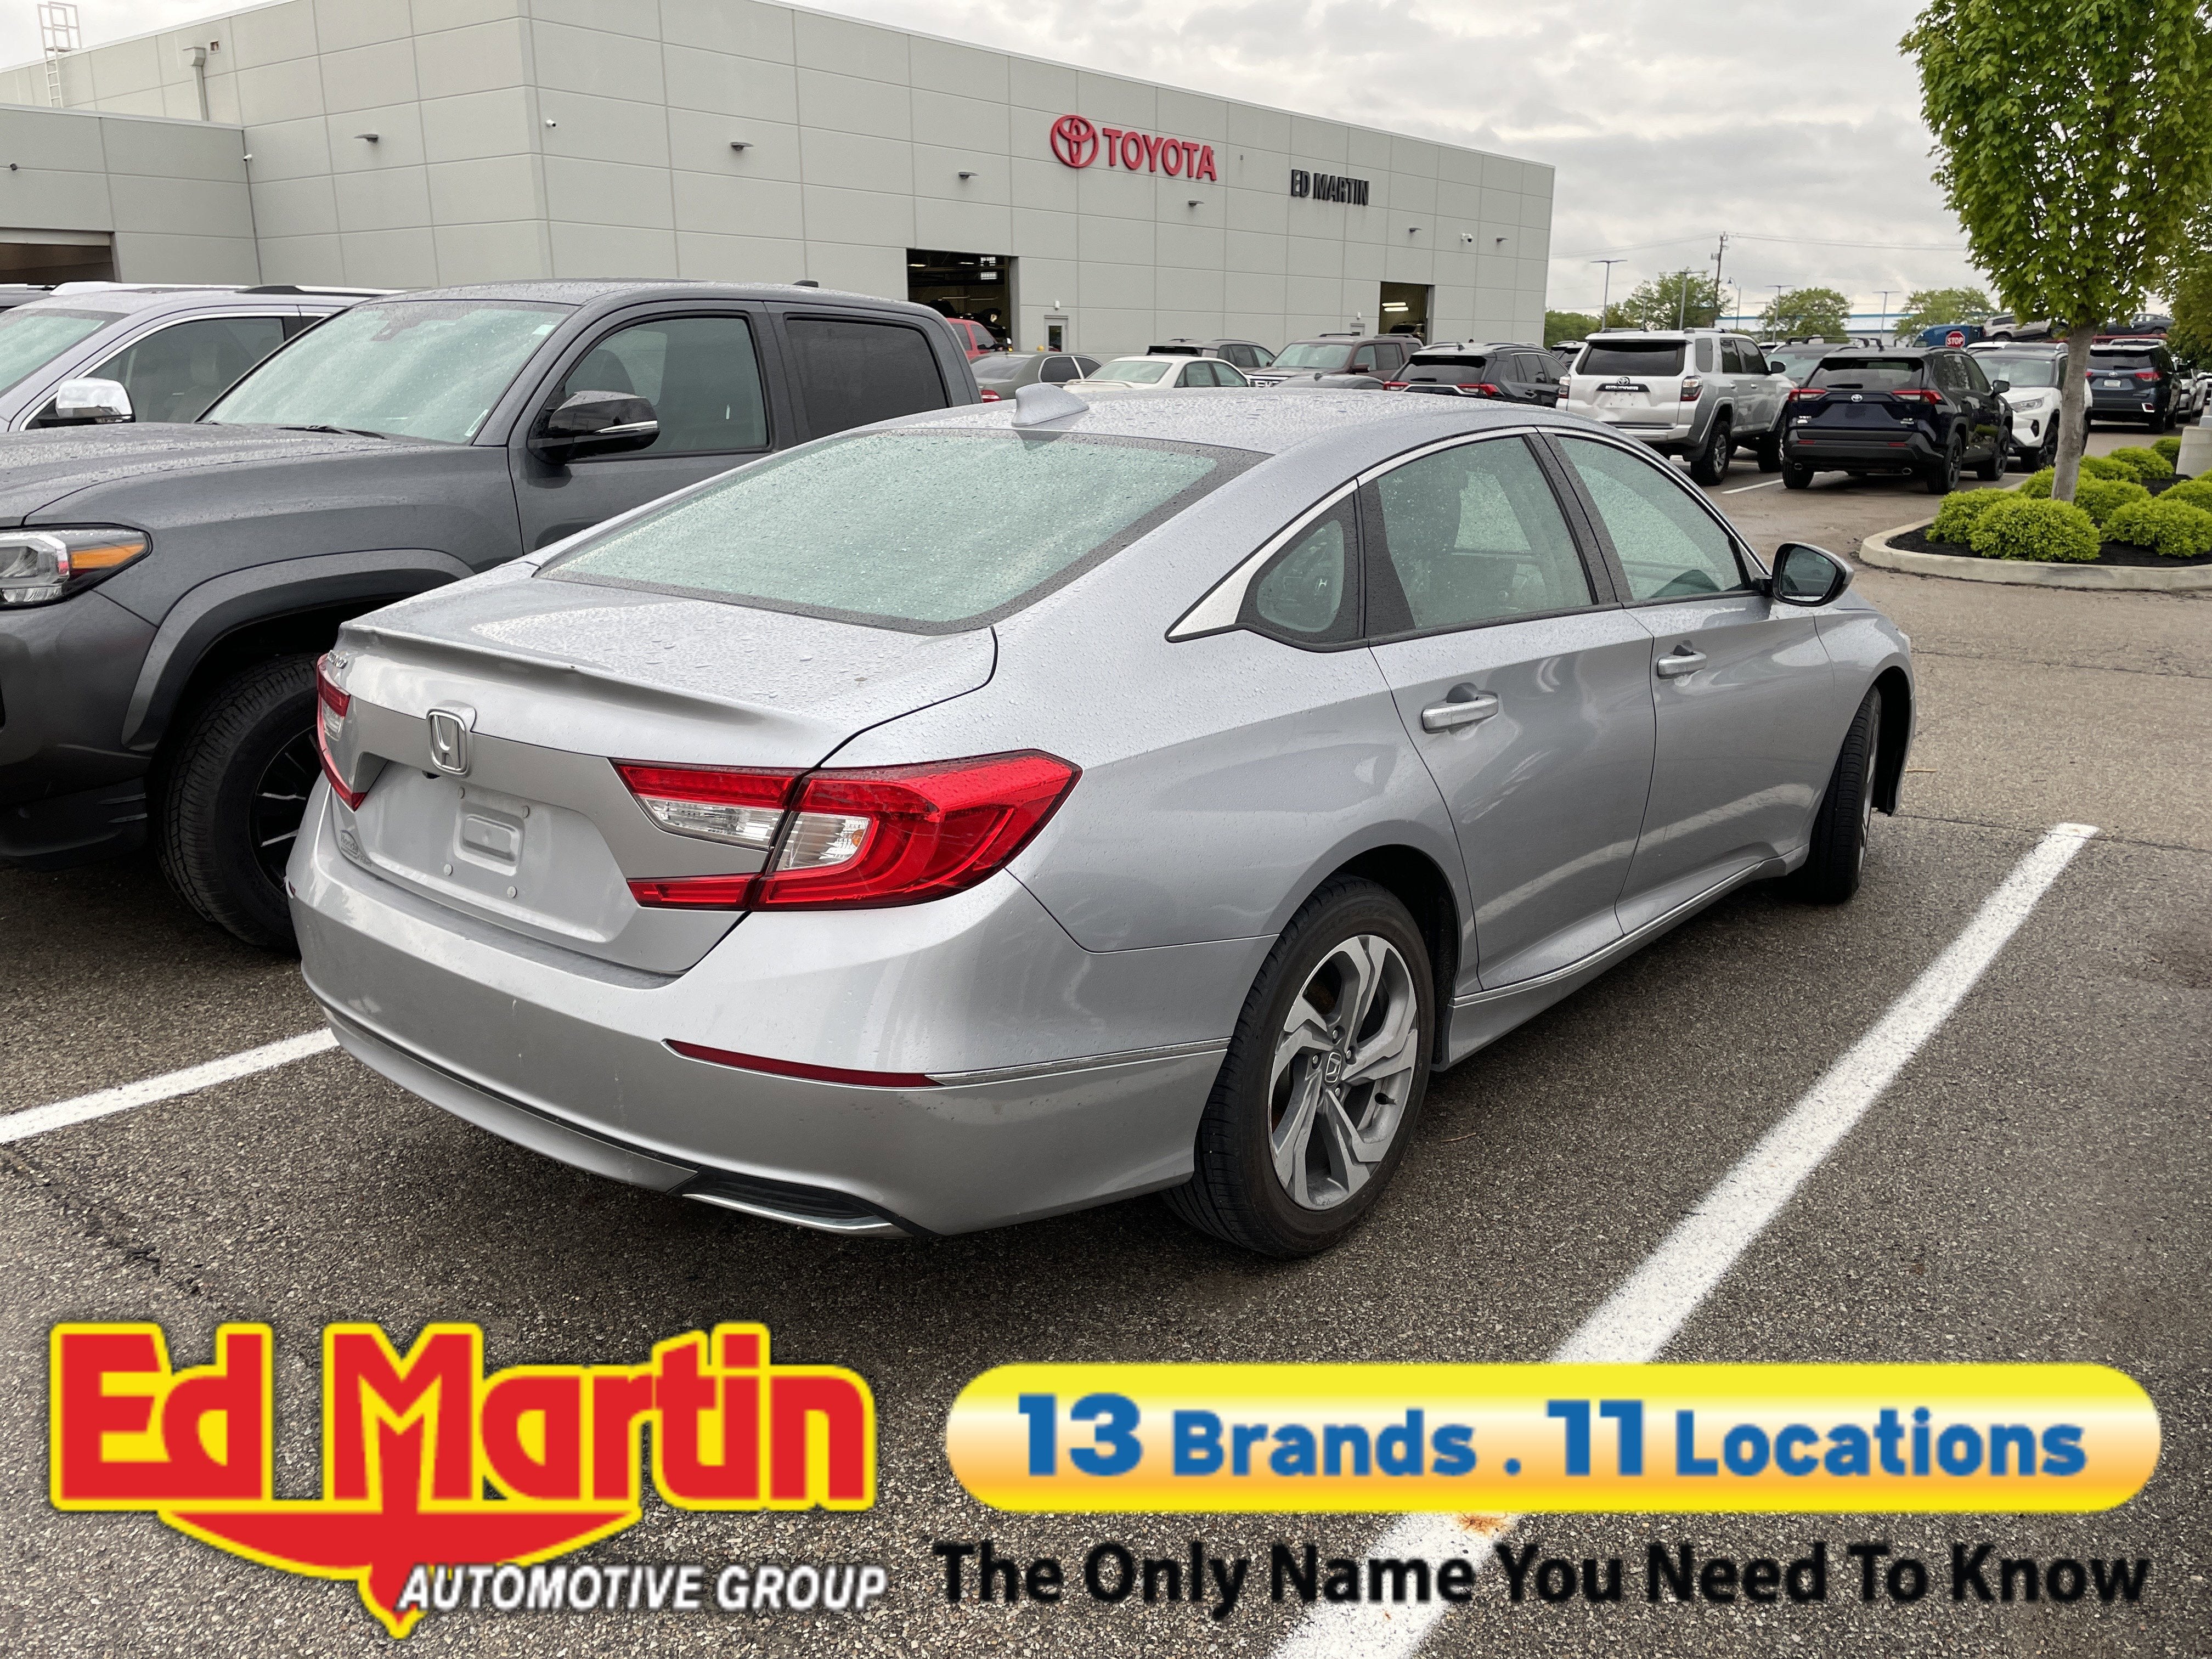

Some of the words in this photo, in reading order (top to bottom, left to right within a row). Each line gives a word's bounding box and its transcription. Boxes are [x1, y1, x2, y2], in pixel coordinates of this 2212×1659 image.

[1102, 127, 1217, 181] TOYOTA
[1291, 169, 1310, 198] ED
[1313, 172, 1369, 206] MARTIN
[1947, 337, 1963, 345] STOP
